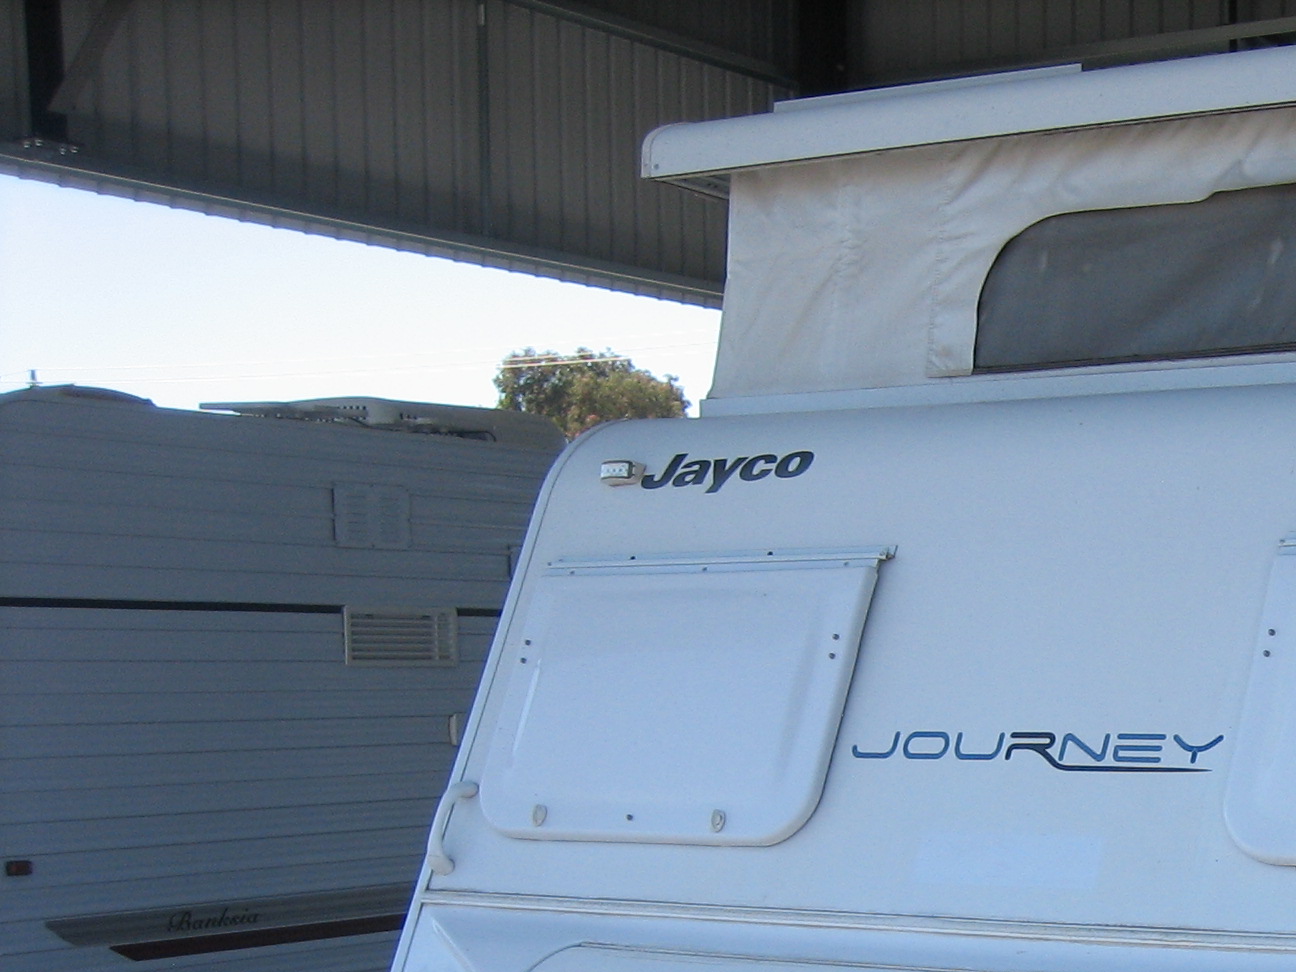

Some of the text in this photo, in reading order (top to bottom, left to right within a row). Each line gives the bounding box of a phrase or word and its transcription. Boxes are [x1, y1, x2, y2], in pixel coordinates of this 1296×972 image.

[641, 451, 814, 493] Jayco
[852, 731, 1224, 772] JOURNEY
[167, 907, 260, 932] Banksia
